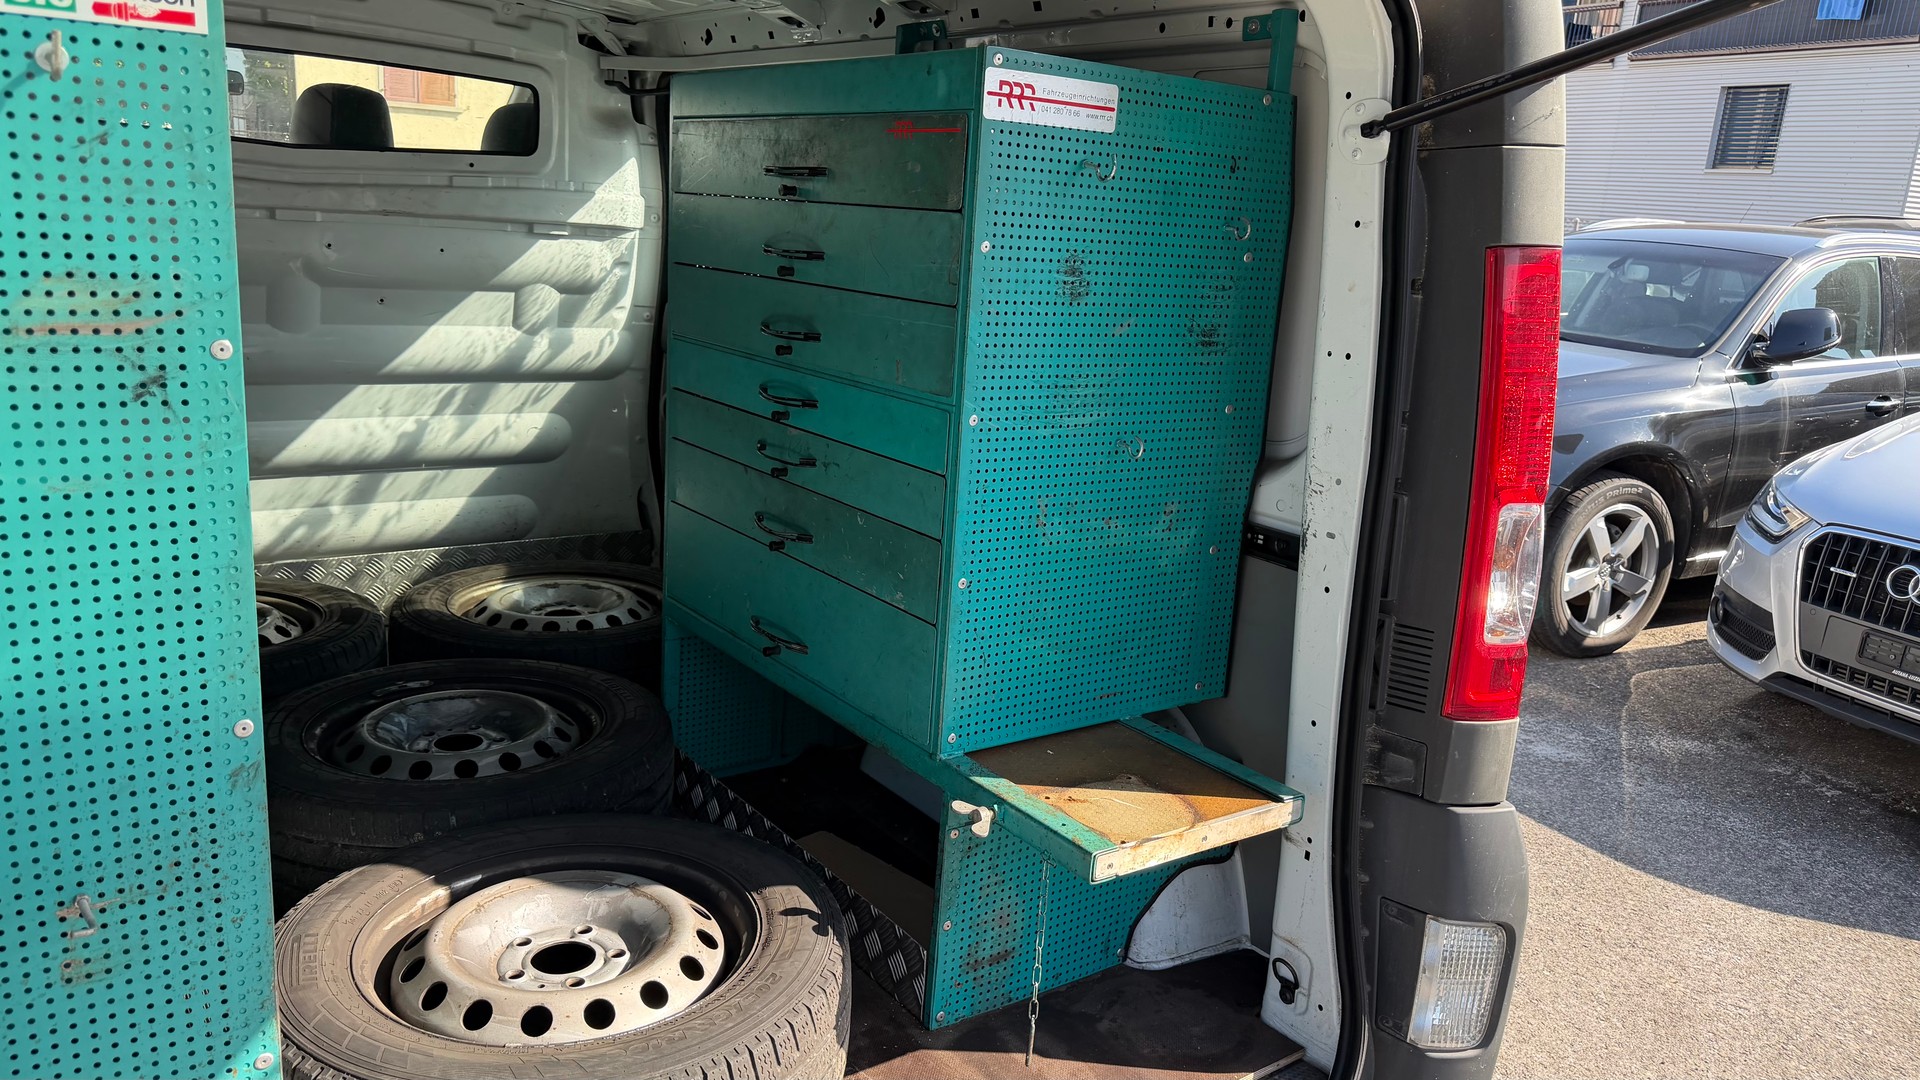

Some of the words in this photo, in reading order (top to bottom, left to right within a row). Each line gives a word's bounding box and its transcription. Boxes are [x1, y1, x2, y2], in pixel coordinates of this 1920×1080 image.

[1042, 87, 1116, 105] Fahrzeugeinrichtungen
[1040, 105, 1052, 114] 041
[1053, 106, 1064, 115] 280
